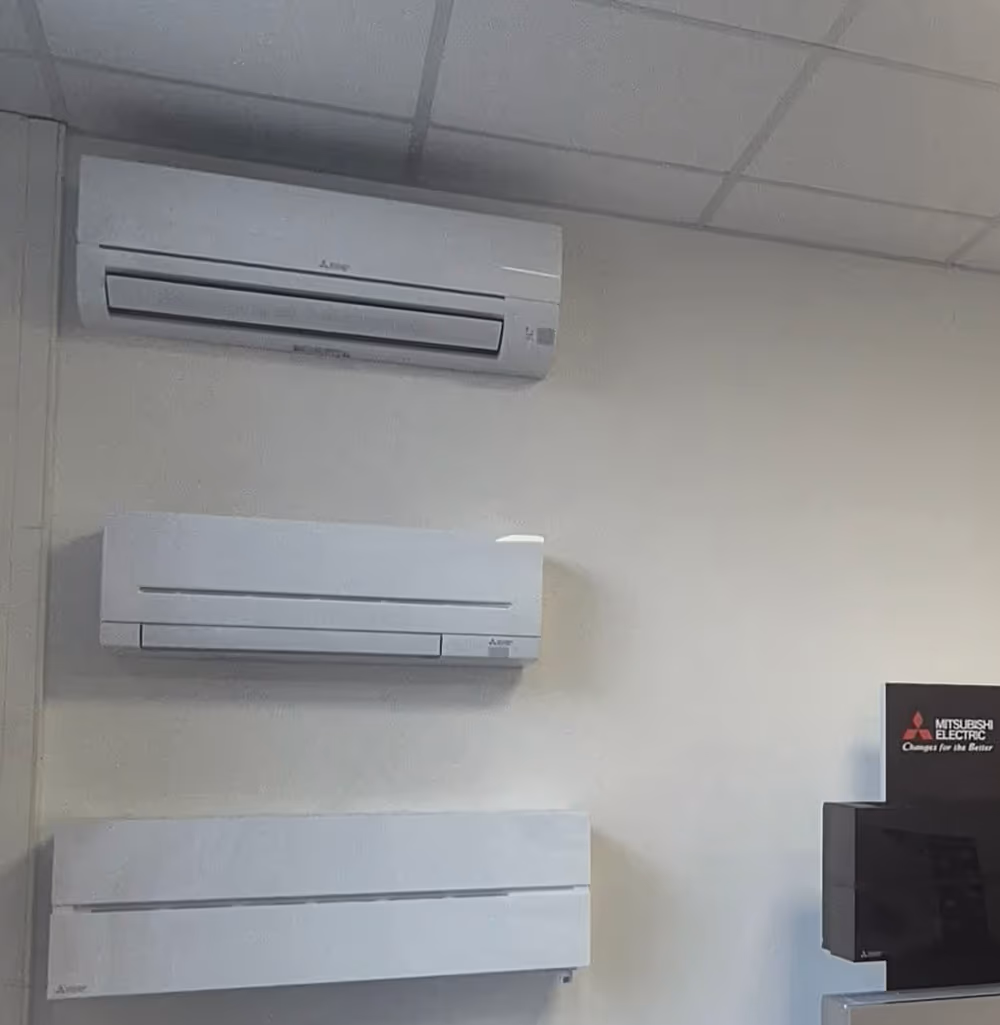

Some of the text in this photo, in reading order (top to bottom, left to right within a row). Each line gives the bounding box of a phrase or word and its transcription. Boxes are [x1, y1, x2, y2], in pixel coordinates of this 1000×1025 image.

[935, 718, 994, 730] MITSUBISHI
[935, 729, 987, 741] ELECTRIC
[939, 743, 952, 752] for
